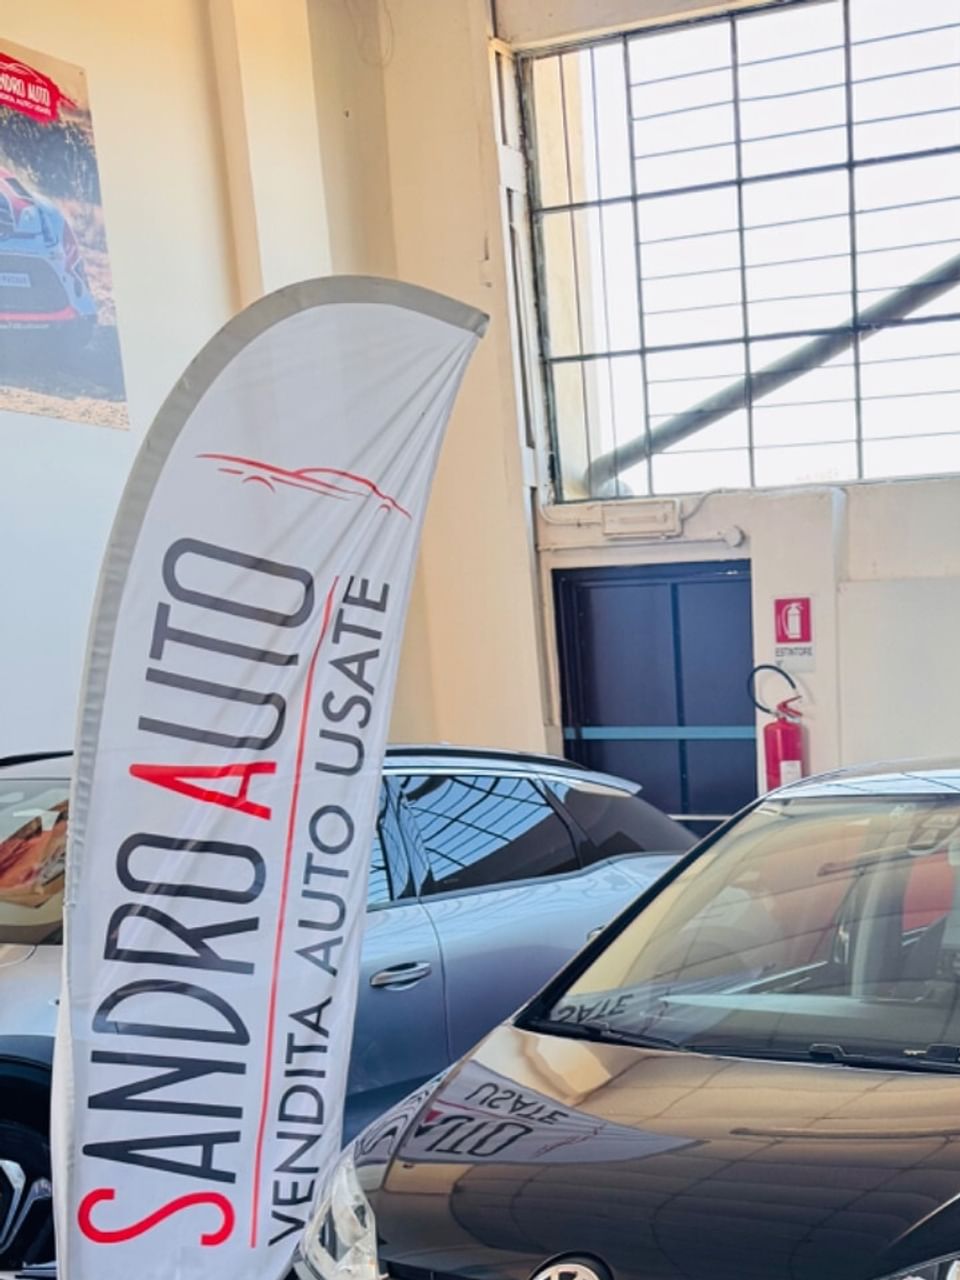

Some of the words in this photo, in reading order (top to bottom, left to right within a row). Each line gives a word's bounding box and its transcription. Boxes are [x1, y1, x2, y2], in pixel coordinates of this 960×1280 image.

[27, 82, 51, 107] AUTO
[129, 538, 315, 820] AUTO
[315, 576, 390, 776] USATE
[295, 805, 355, 976] AUTO
[77, 832, 266, 1248] SANDRO
[268, 997, 332, 1247] VENDITA
